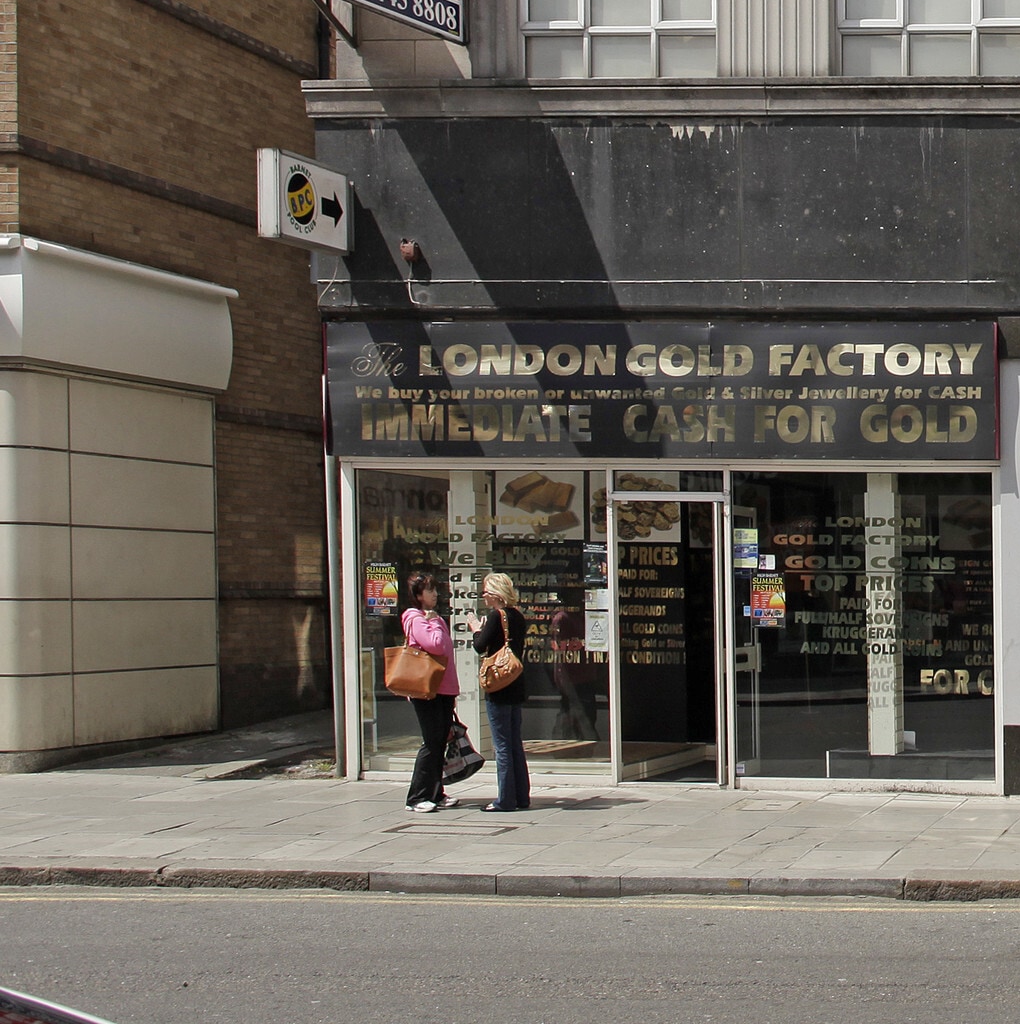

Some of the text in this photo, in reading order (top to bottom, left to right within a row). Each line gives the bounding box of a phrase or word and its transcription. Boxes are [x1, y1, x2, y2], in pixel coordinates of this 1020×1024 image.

[351, 342, 984, 377] The LONDON GOLD FACTORY
[355, 386, 982, 403] We buy your broken or unwanted Gold & Silver Jewellery for CASH
[360, 403, 979, 444] IMMEDIATE CASH FOR GOLD
[455, 516, 551, 526] LONDON
[825, 516, 921, 528] LONDON
[471, 533, 567, 544] FACTORY
[773, 534, 941, 546] GOLD FACTORY
[429, 550, 474, 566] We
[630, 546, 679, 566] PRICES
[784, 555, 862, 570] GOLD
[870, 555, 956, 571] COINS
[366, 566, 396, 574] SUMMER
[618, 568, 637, 580] PAID
[752, 577, 784, 585] SUMMER
[801, 575, 935, 593] TOP PRICES
[634, 587, 685, 600] SOVEREIGNS
[752, 584, 784, 592] FESTIVAL
[840, 598, 870, 611] PAID
[794, 611, 863, 625] FULL/HALF
[632, 622, 684, 635] GOLD COINS
[962, 624, 979, 636] WE
[642, 638, 657, 648] Gold
[800, 641, 830, 655] AND
[833, 641, 858, 655] ALL
[862, 642, 898, 656] GOLD
[527, 649, 581, 664] CONDITION
[593, 650, 603, 664] IN
[627, 651, 681, 665] CONDITION
[921, 669, 970, 694] FOR
